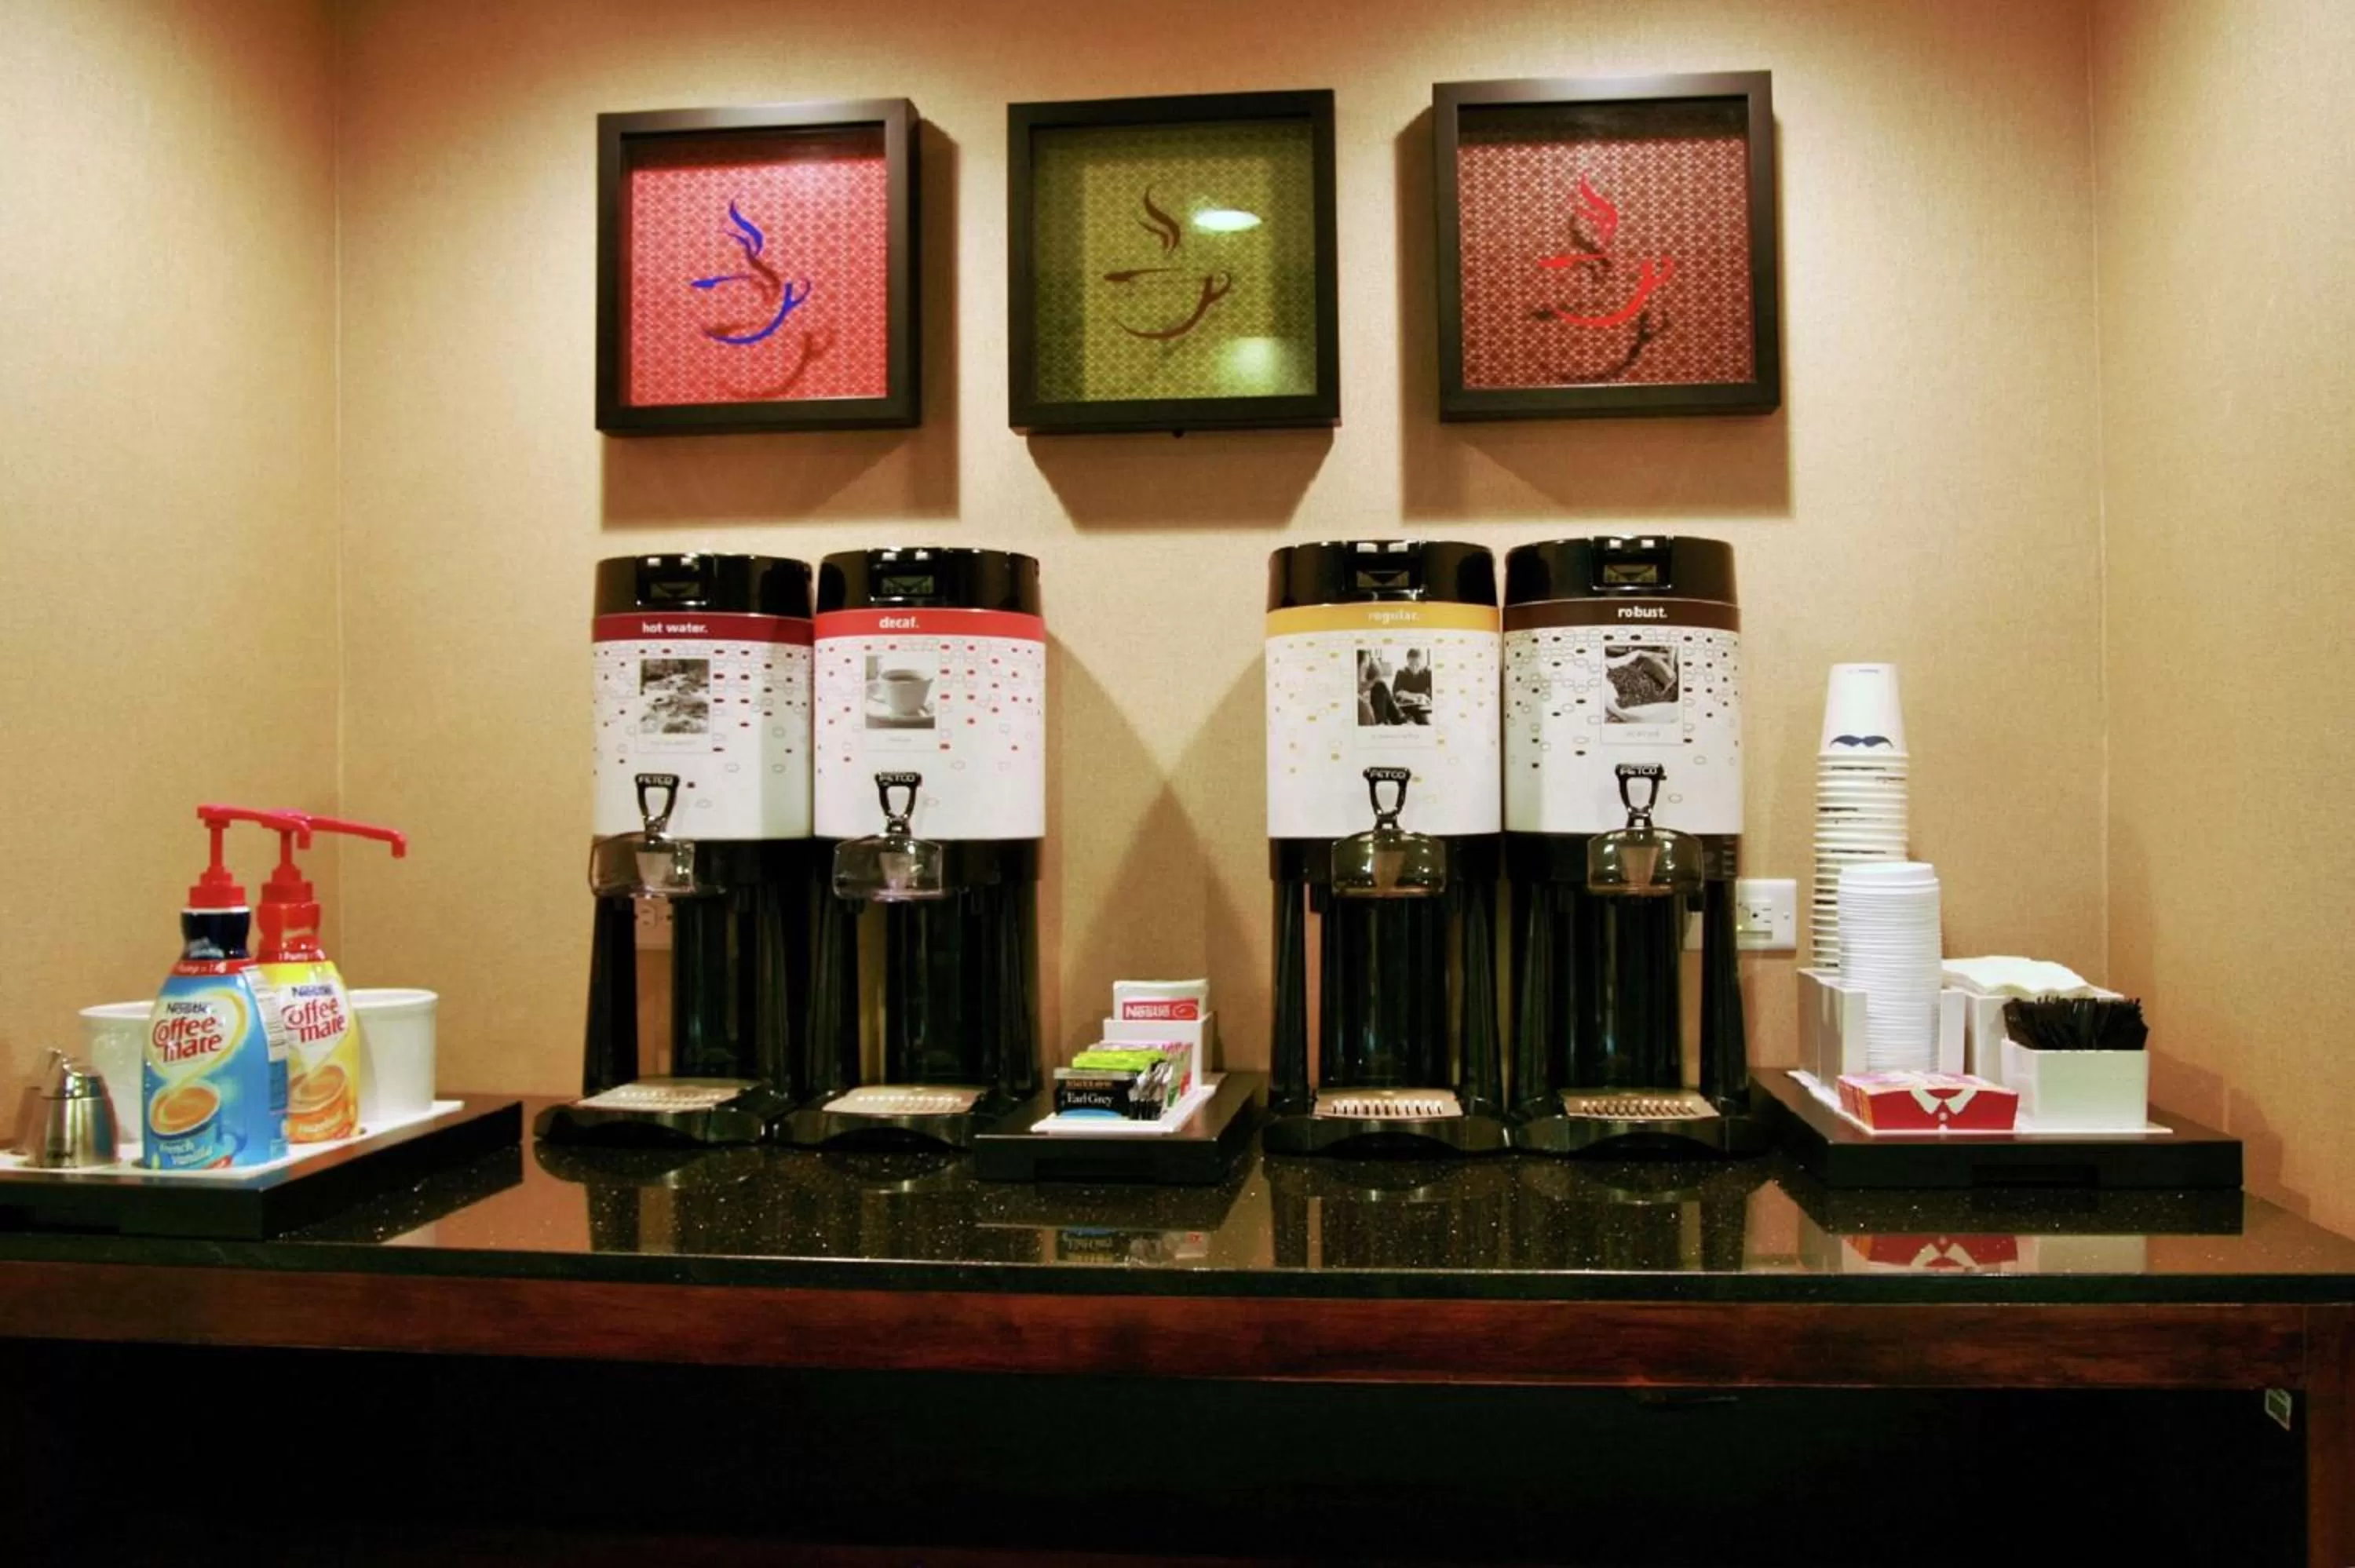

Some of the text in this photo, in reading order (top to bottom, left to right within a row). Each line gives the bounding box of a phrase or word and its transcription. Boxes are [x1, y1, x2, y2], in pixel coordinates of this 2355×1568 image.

[1618, 606, 1667, 618] robust.
[642, 621, 708, 633] hot water.
[879, 616, 920, 629] decaf.
[281, 997, 338, 1030] Coffee
[152, 1016, 216, 1048] Coffee
[299, 1016, 345, 1043] mate
[163, 1034, 222, 1063] mate
[1067, 1092, 1087, 1103] Earl
